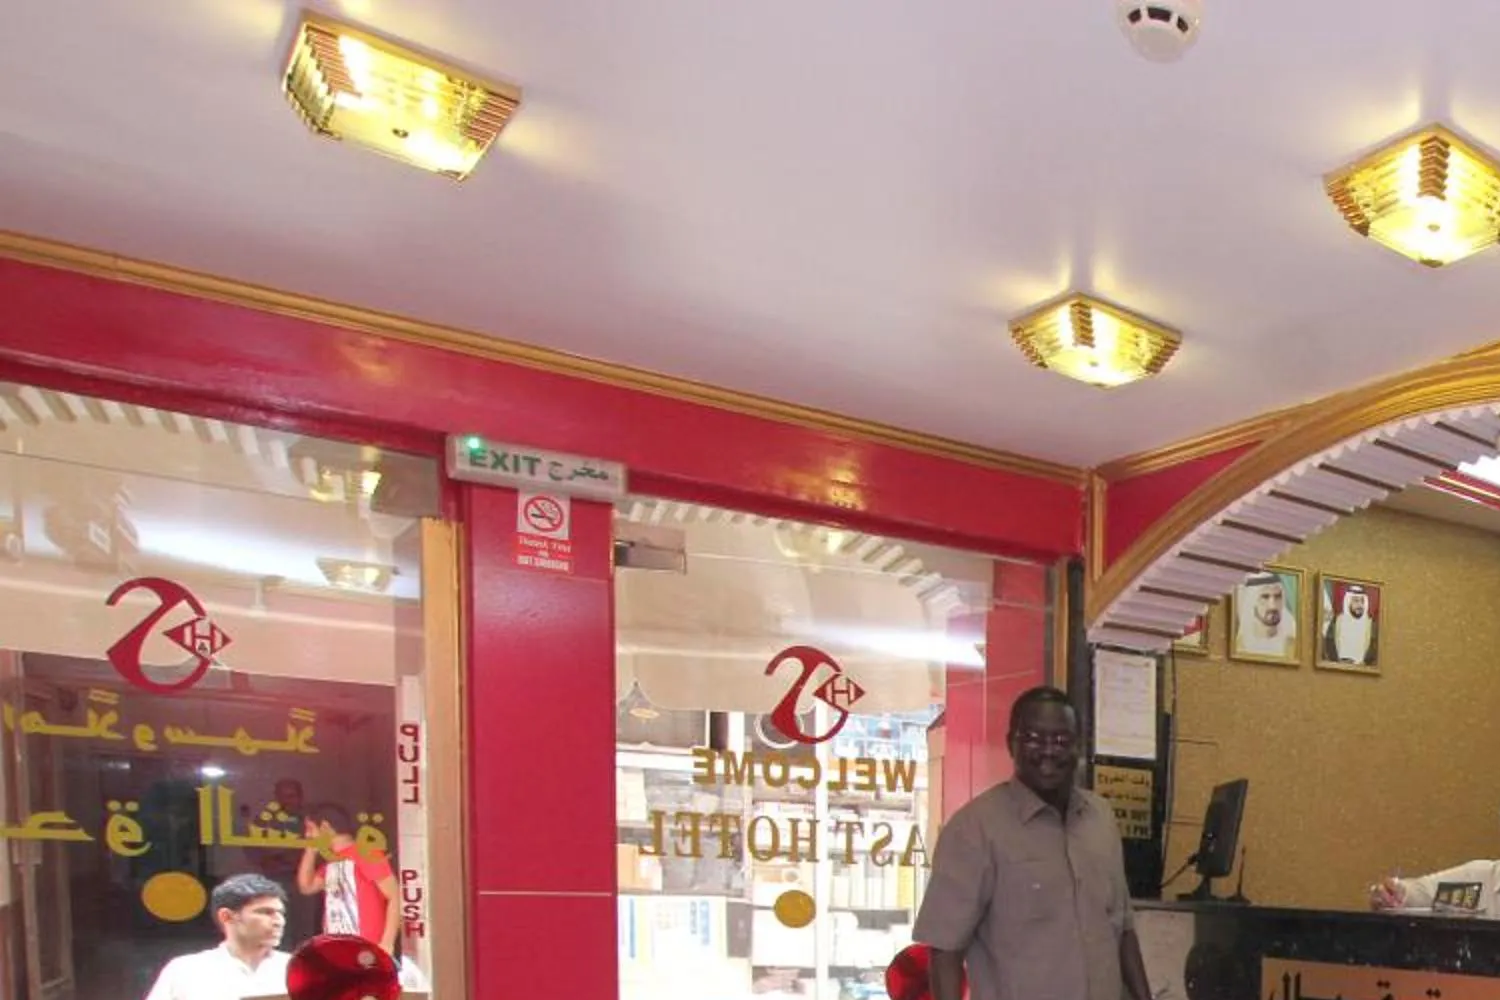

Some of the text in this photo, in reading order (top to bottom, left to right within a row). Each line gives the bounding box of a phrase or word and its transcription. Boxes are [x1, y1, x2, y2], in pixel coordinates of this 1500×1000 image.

[469, 449, 541, 477] EXIT
[548, 459, 609, 481] مخرج
[401, 869, 425, 938] PUSH
